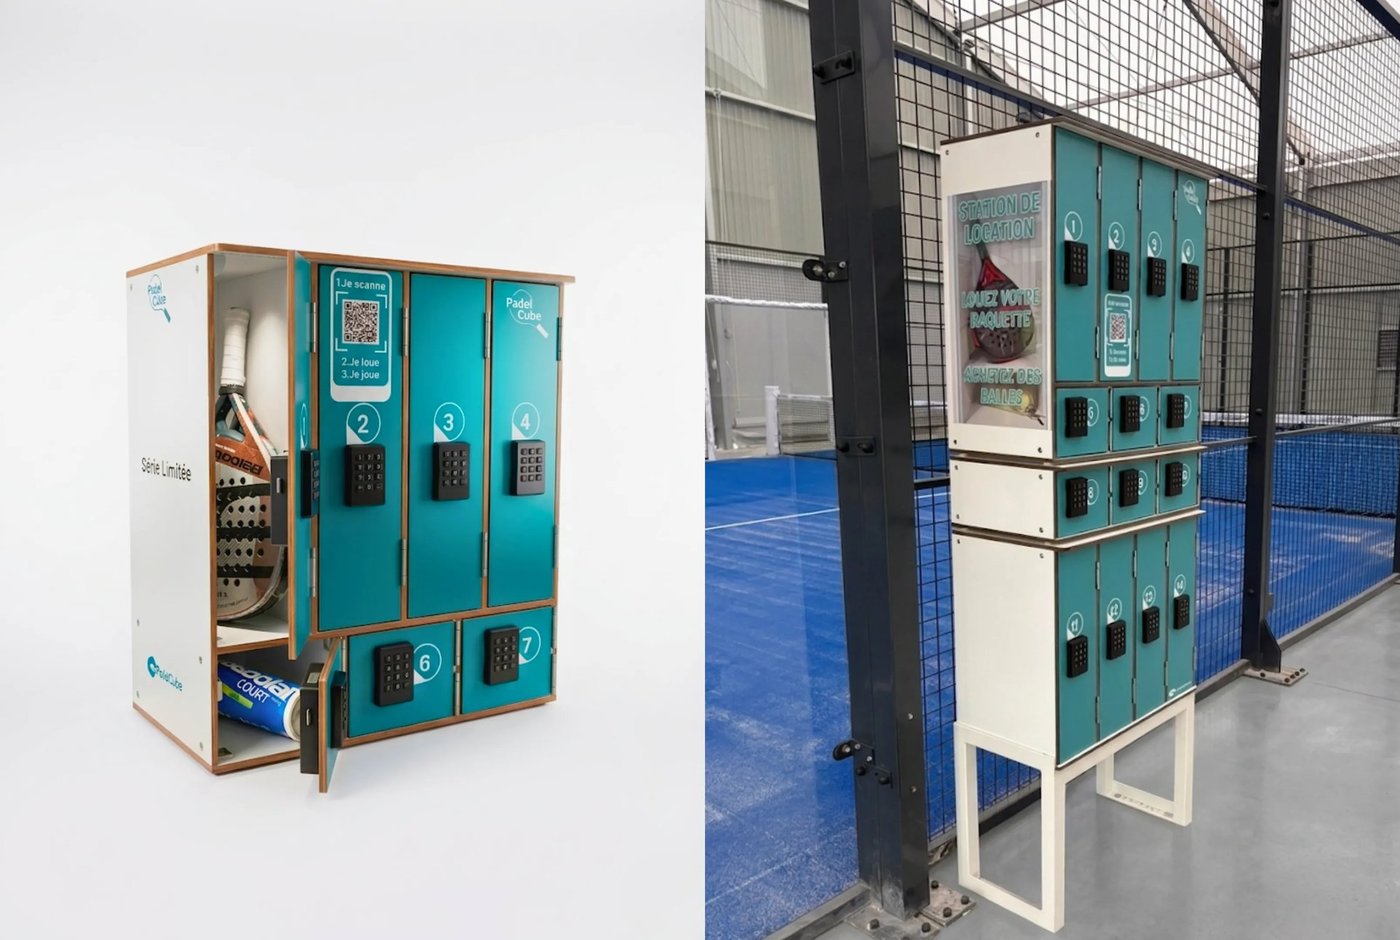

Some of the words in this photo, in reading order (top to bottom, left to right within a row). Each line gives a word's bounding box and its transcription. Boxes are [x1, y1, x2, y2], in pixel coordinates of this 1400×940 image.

[959, 193, 1018, 222] STATION
[1020, 191, 1041, 214] DE
[964, 217, 1035, 246] LOCATION
[1072, 220, 1076, 234] 1
[1113, 229, 1120, 243] 2
[354, 280, 386, 291] scanne
[506, 297, 533, 309] Padel
[517, 309, 542, 321] Cube
[341, 356, 360, 367] 2.Je
[361, 357, 380, 368] loue
[341, 369, 360, 379] 3.Je
[360, 369, 380, 380] joue
[980, 387, 1023, 405] BALLES
[357, 415, 369, 434] 2
[443, 413, 455, 432] 3
[520, 413, 531, 431] 4
[141, 457, 160, 475] Série
[161, 460, 192, 482] Limitée
[522, 637, 533, 654] 7
[419, 655, 431, 672] 6
[236, 679, 271, 704] COURT
